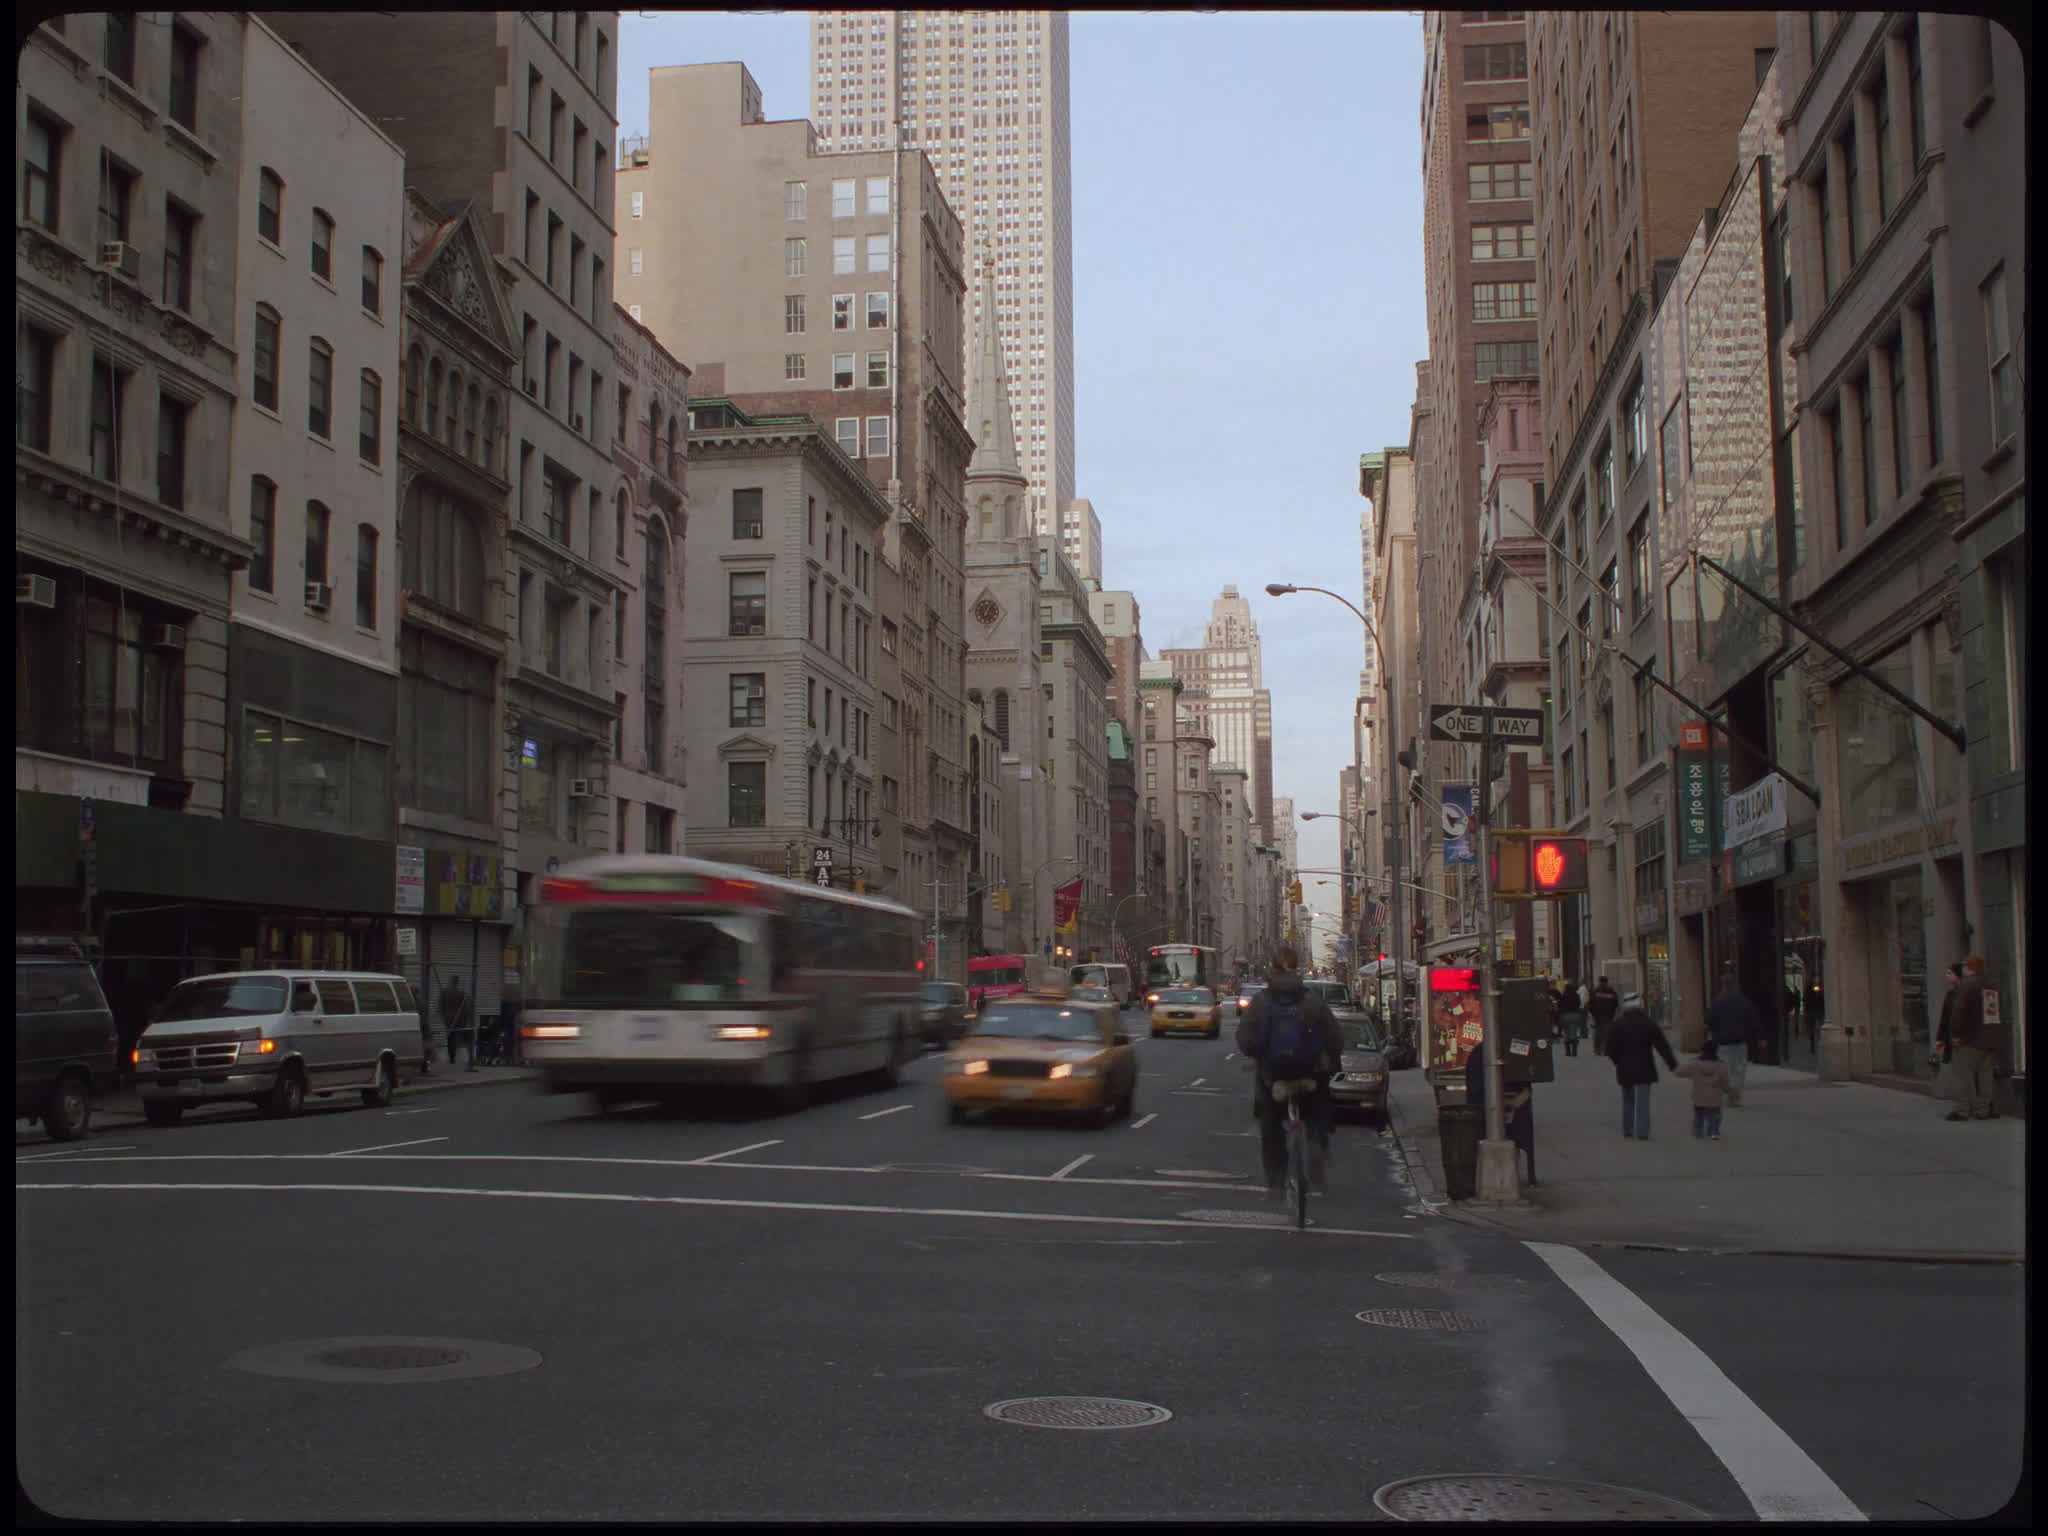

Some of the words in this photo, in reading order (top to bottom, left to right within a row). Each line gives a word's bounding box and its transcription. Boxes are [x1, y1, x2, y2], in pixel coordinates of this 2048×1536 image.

[1446, 716, 1476, 731] ONE
[1498, 719, 1530, 734] WAY
[1688, 764, 1705, 834] 조흥은행
[816, 850, 831, 860] 24
